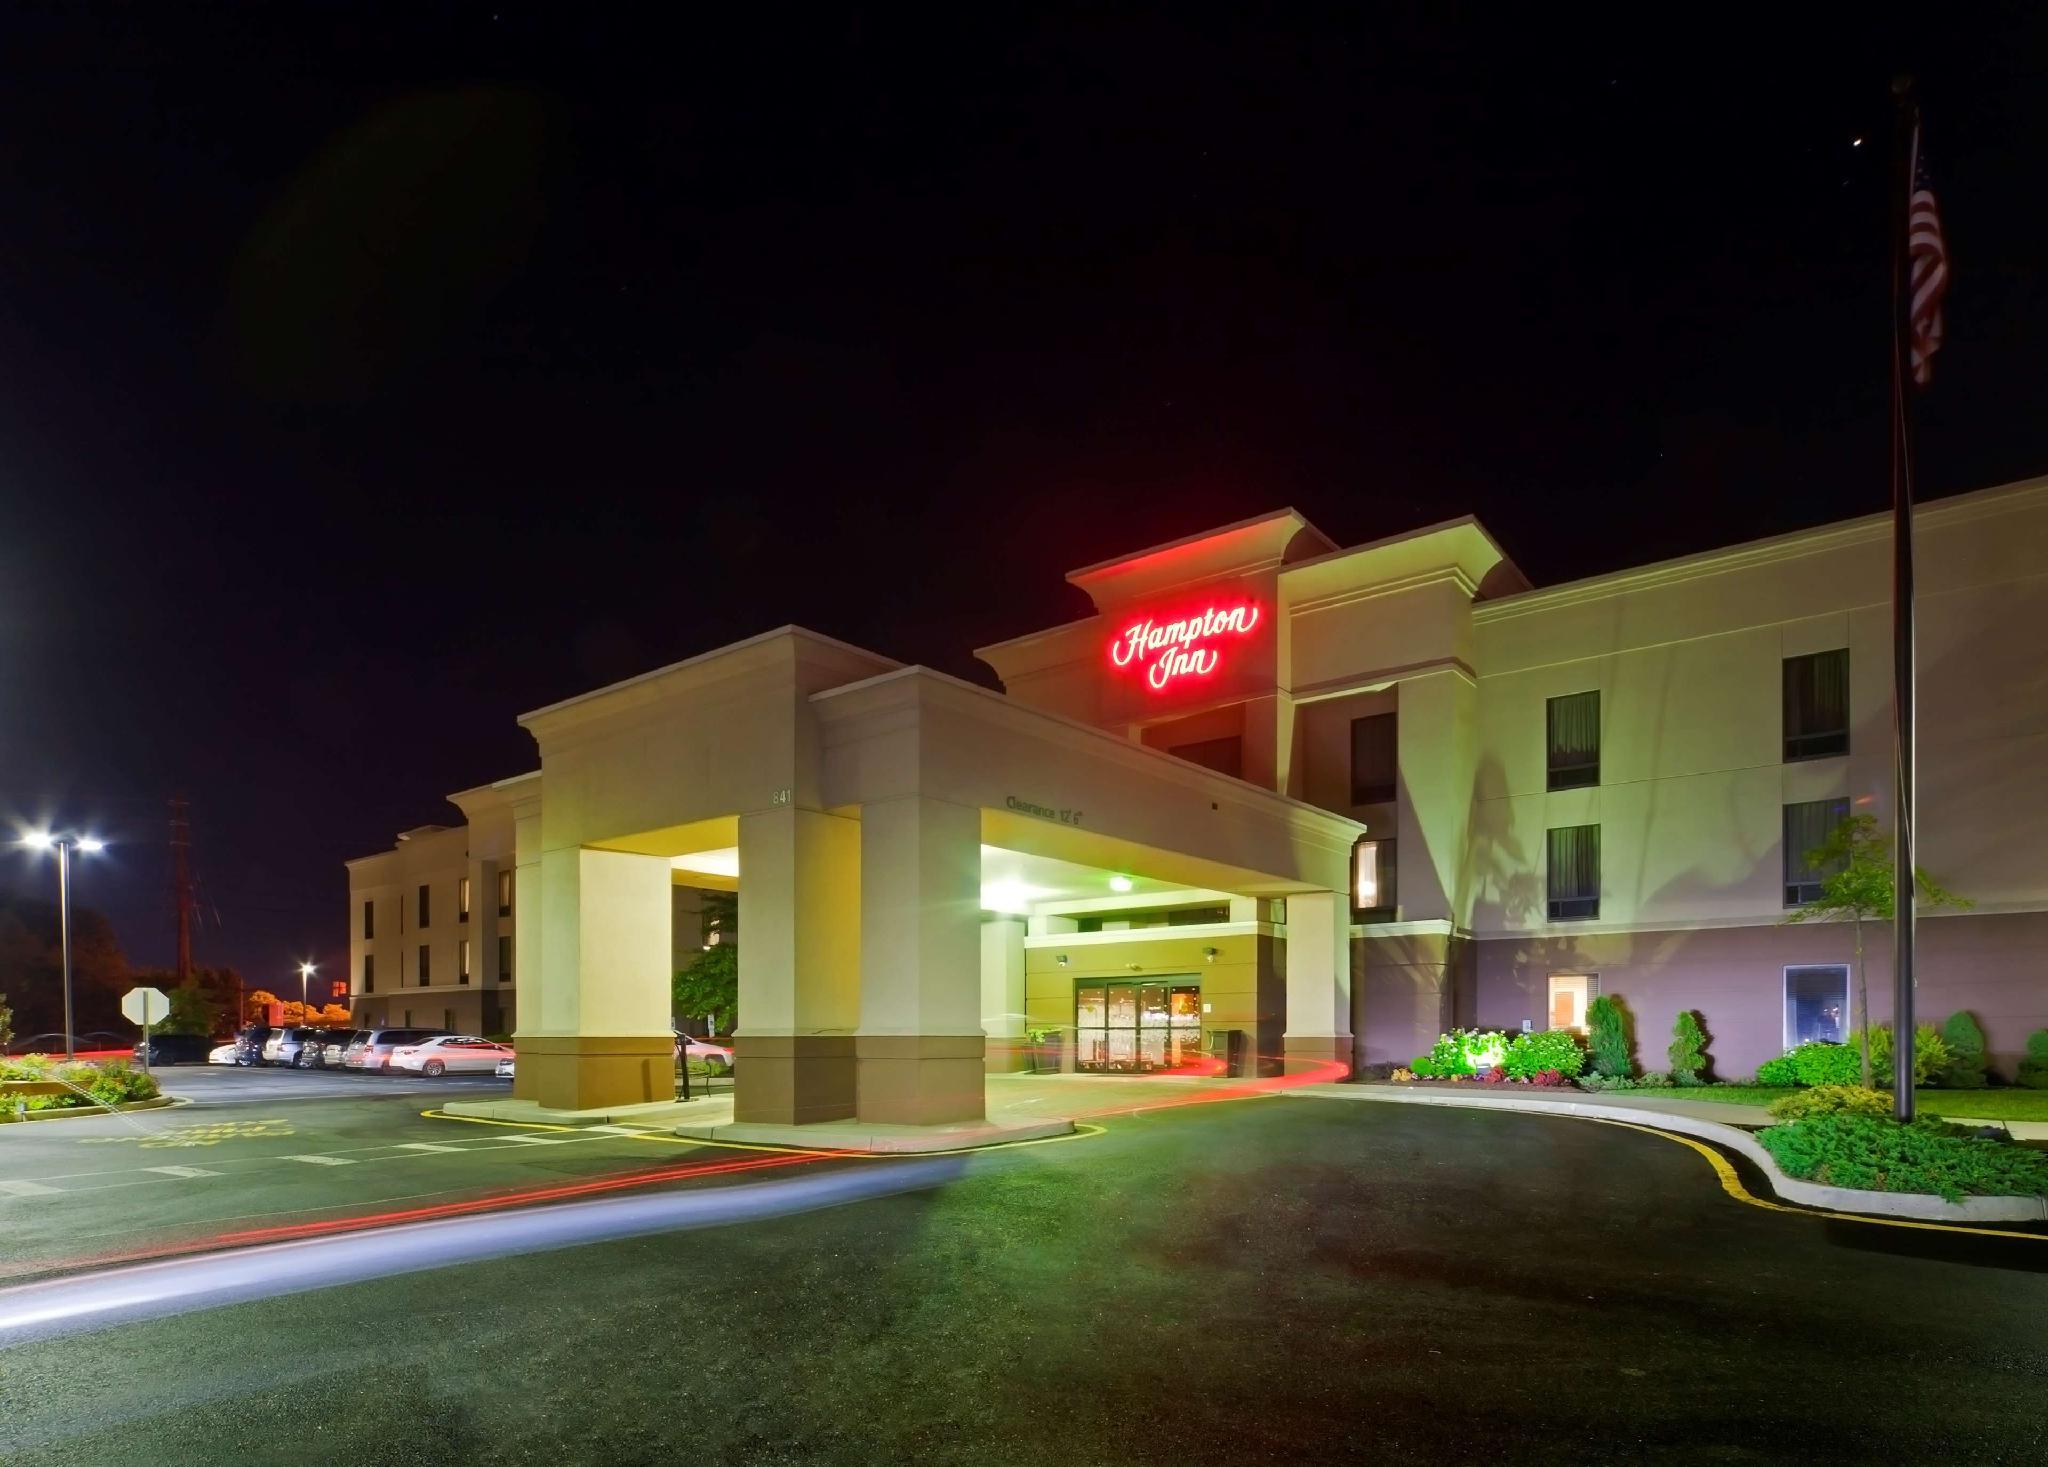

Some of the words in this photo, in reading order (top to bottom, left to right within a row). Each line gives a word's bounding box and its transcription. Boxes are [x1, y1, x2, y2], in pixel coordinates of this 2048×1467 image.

[1112, 606, 1259, 666] Hampton
[1149, 646, 1218, 689] Inn
[772, 789, 791, 804] 841
[1006, 795, 1056, 819] Clearance
